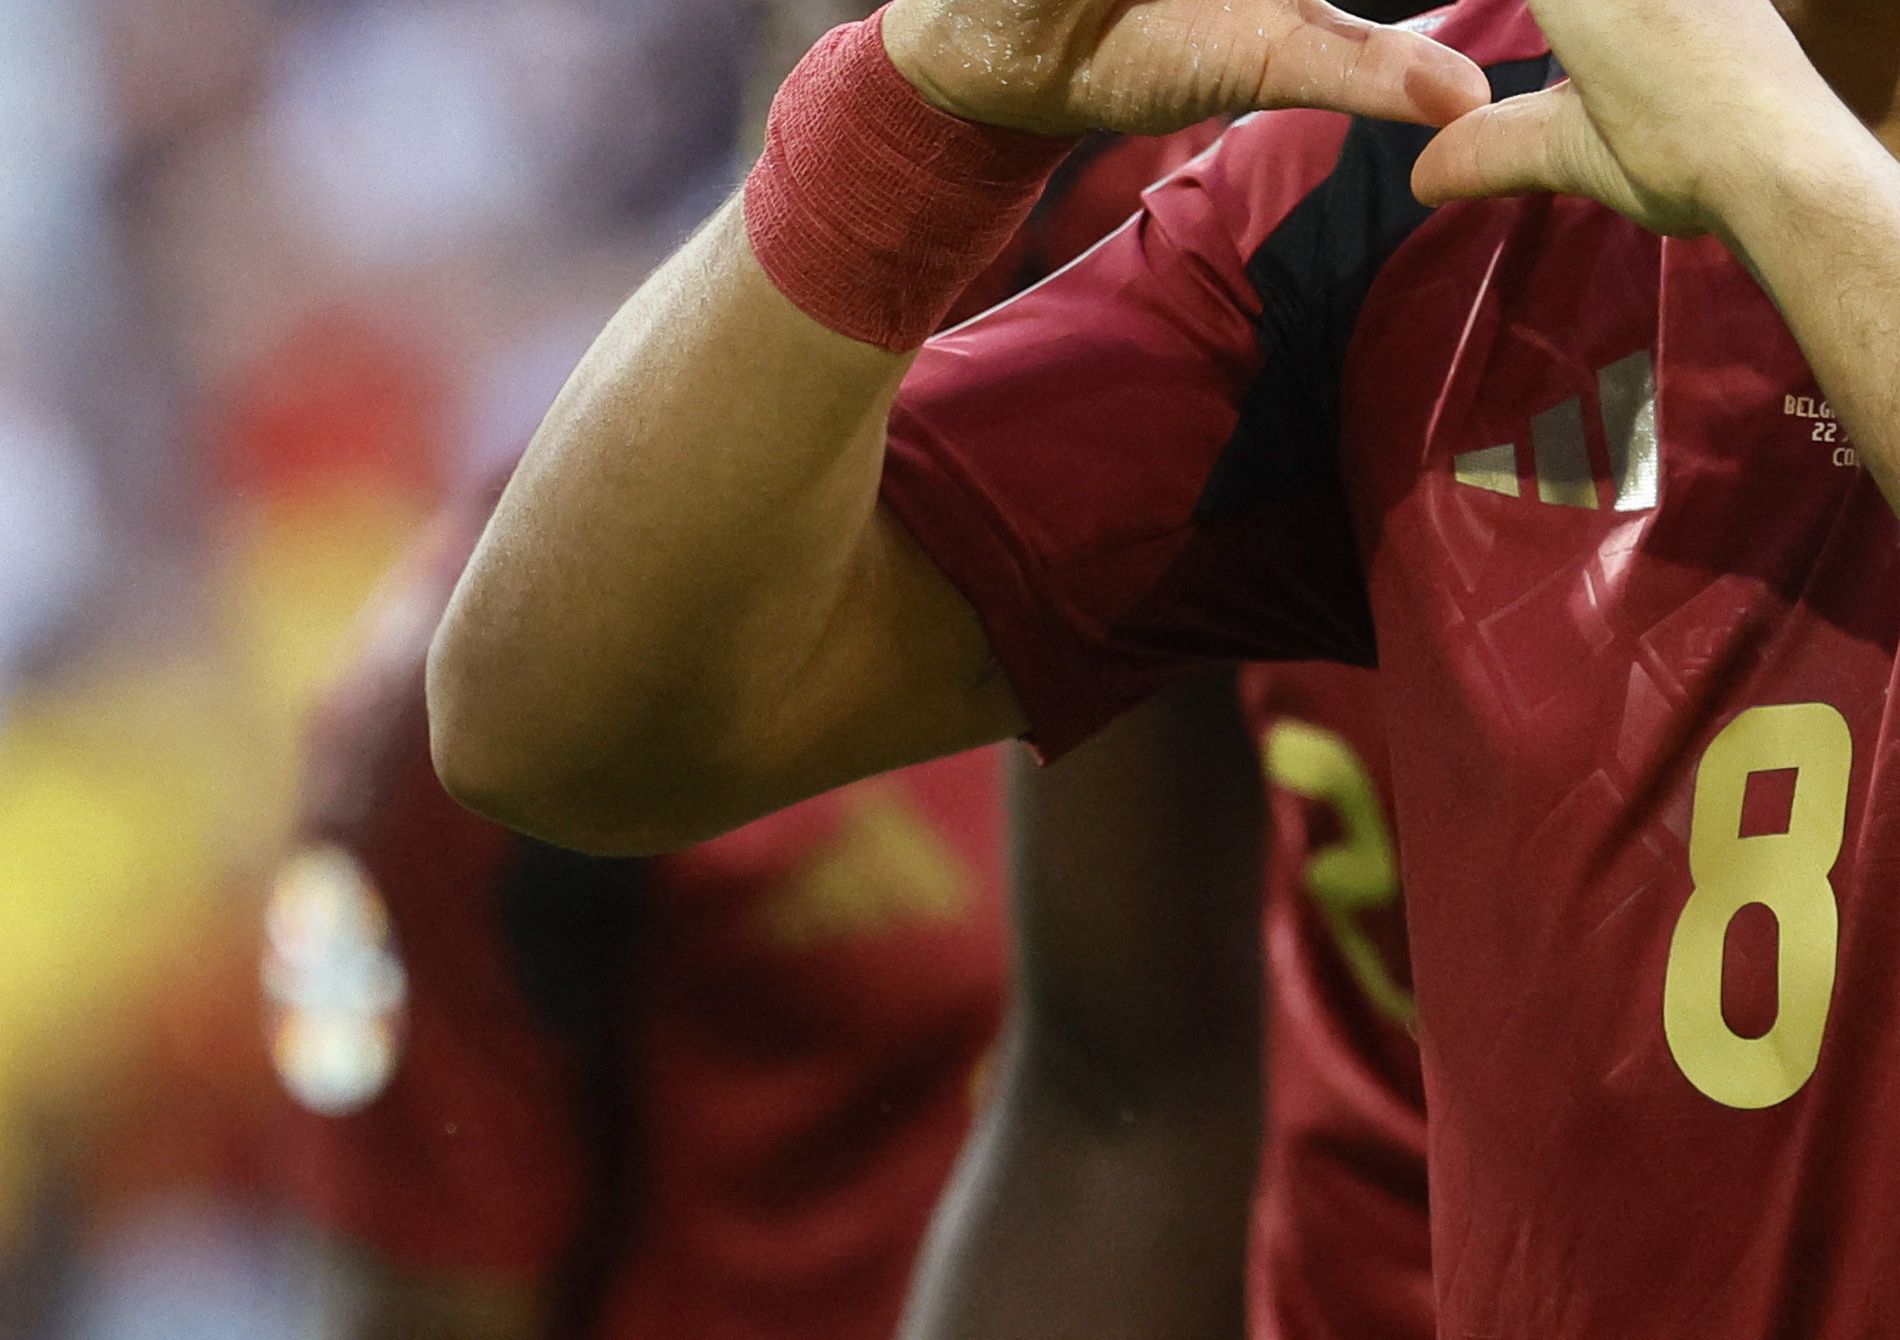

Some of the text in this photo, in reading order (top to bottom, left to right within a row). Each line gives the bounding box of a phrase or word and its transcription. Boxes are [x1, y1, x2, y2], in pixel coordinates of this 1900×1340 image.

[1784, 394, 1836, 418] BELG
[1811, 422, 1837, 442] 22
[1832, 447, 1860, 467] CO
[1664, 702, 1853, 1109] 8
